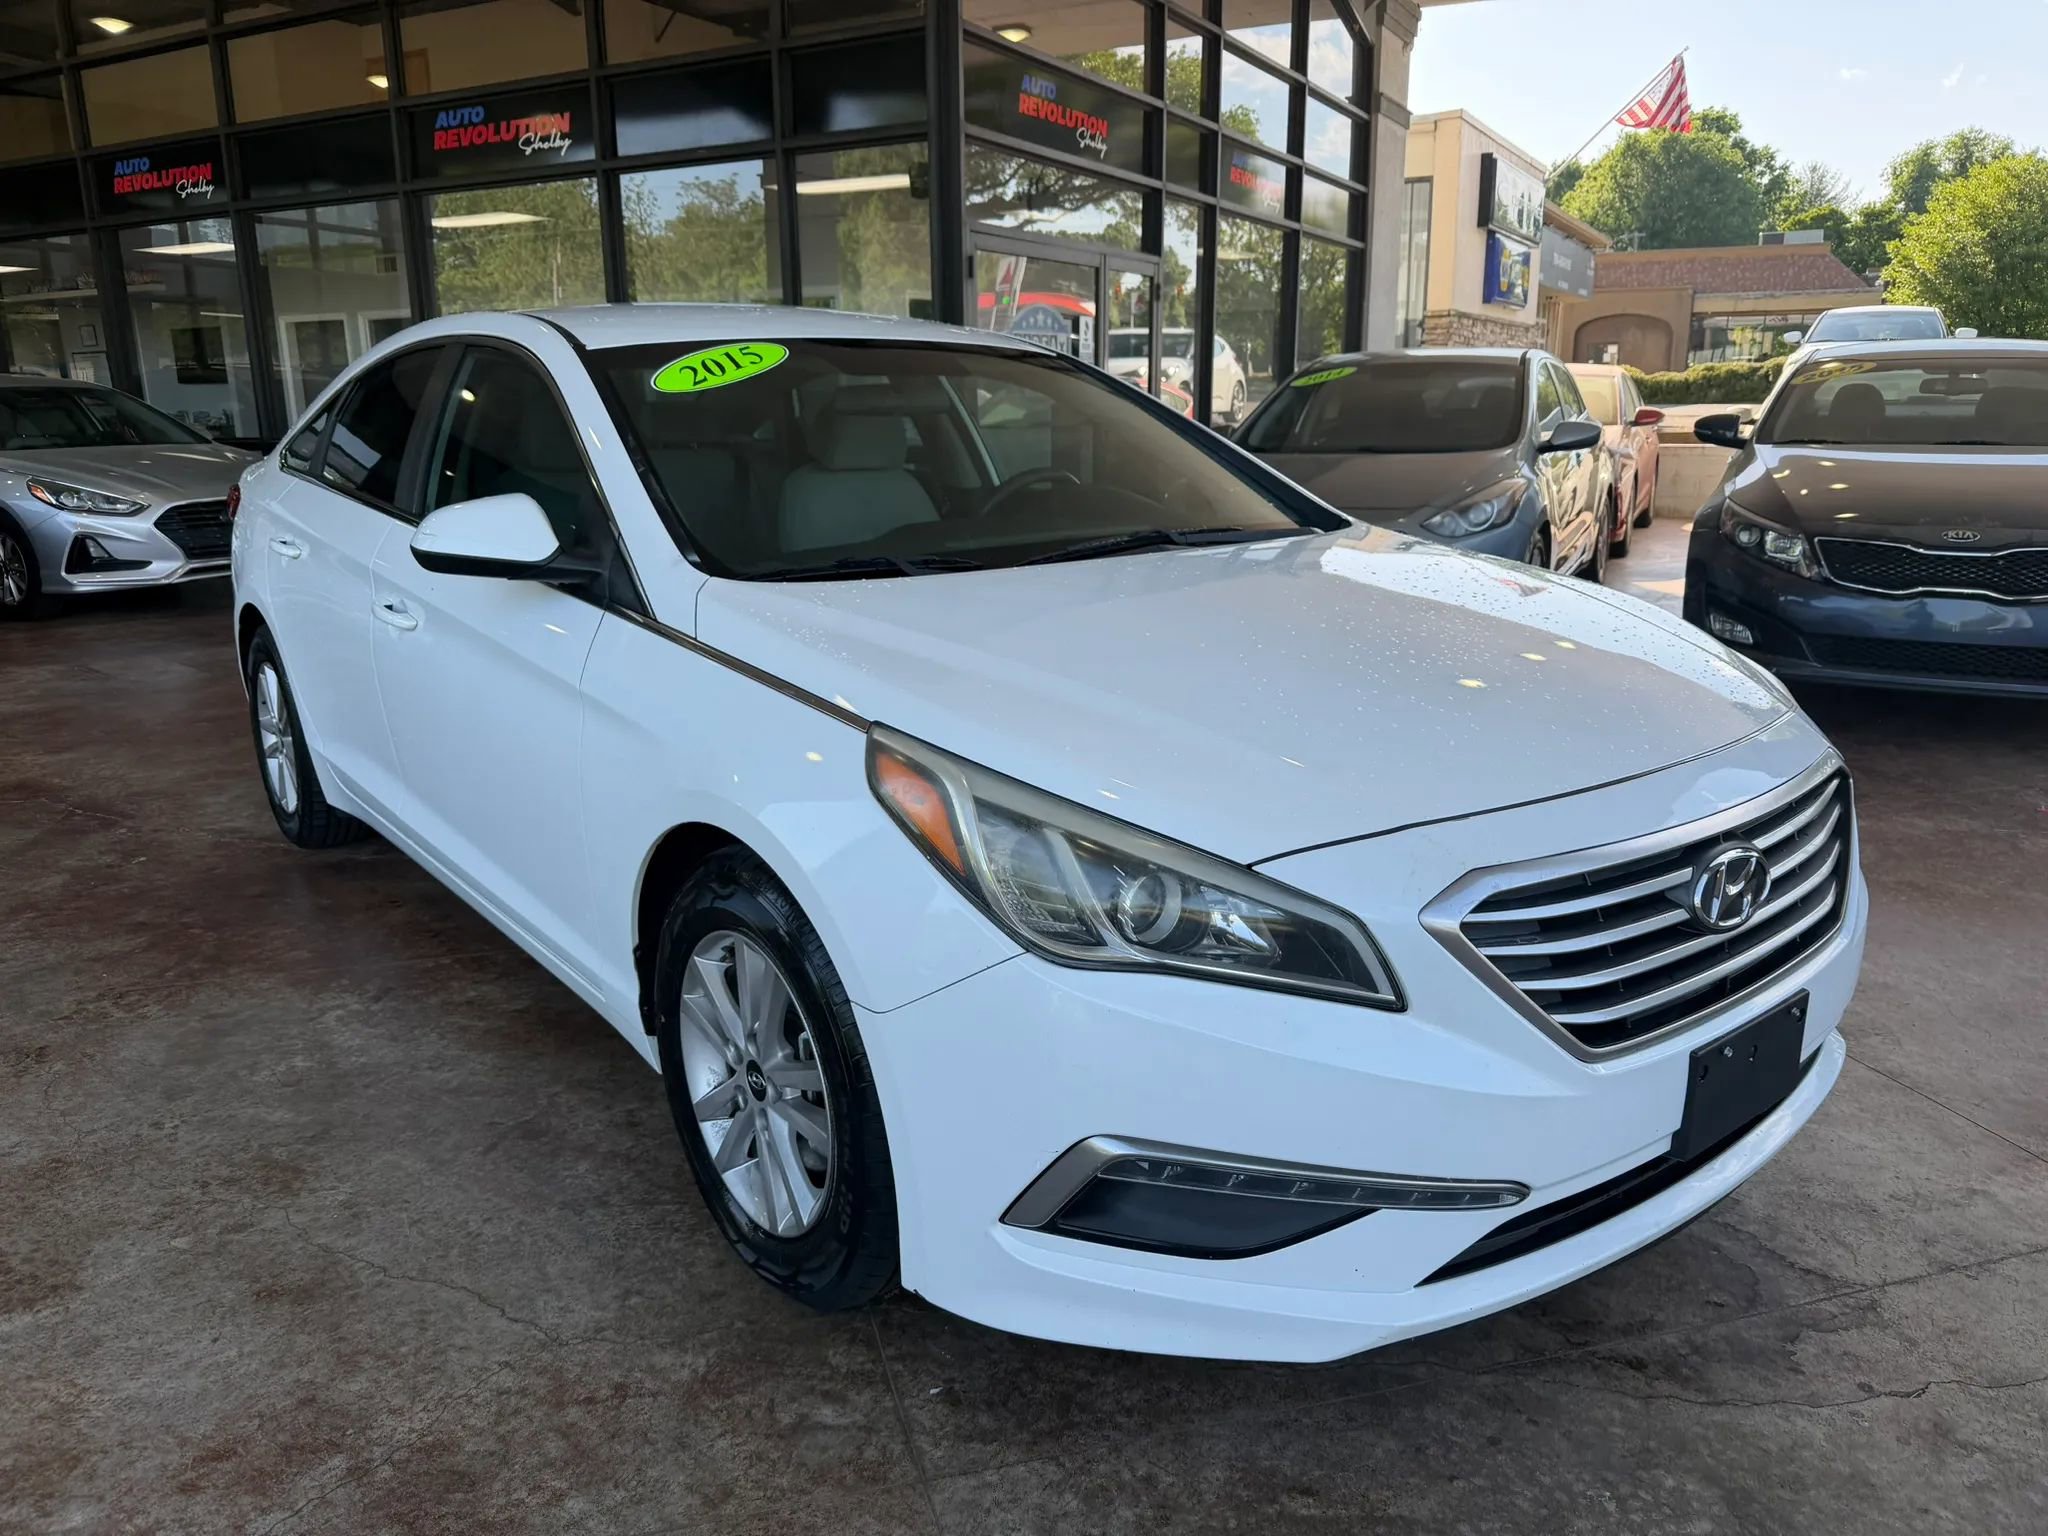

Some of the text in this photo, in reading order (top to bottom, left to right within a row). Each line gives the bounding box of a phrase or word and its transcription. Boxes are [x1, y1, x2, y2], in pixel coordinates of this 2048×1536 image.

[1021, 74, 1057, 100] AUTO
[435, 105, 485, 129] AUTO
[1019, 92, 1109, 138] REVOLUTION
[434, 112, 571, 150] REVOLUTION
[518, 128, 573, 156] Shelby
[1076, 127, 1108, 159] Shelby
[113, 162, 212, 194] REVOLUTION
[114, 157, 150, 176] AUTO
[176, 176, 215, 200] Shelby
[679, 346, 764, 387] 2015
[1946, 529, 1975, 540] KIA
